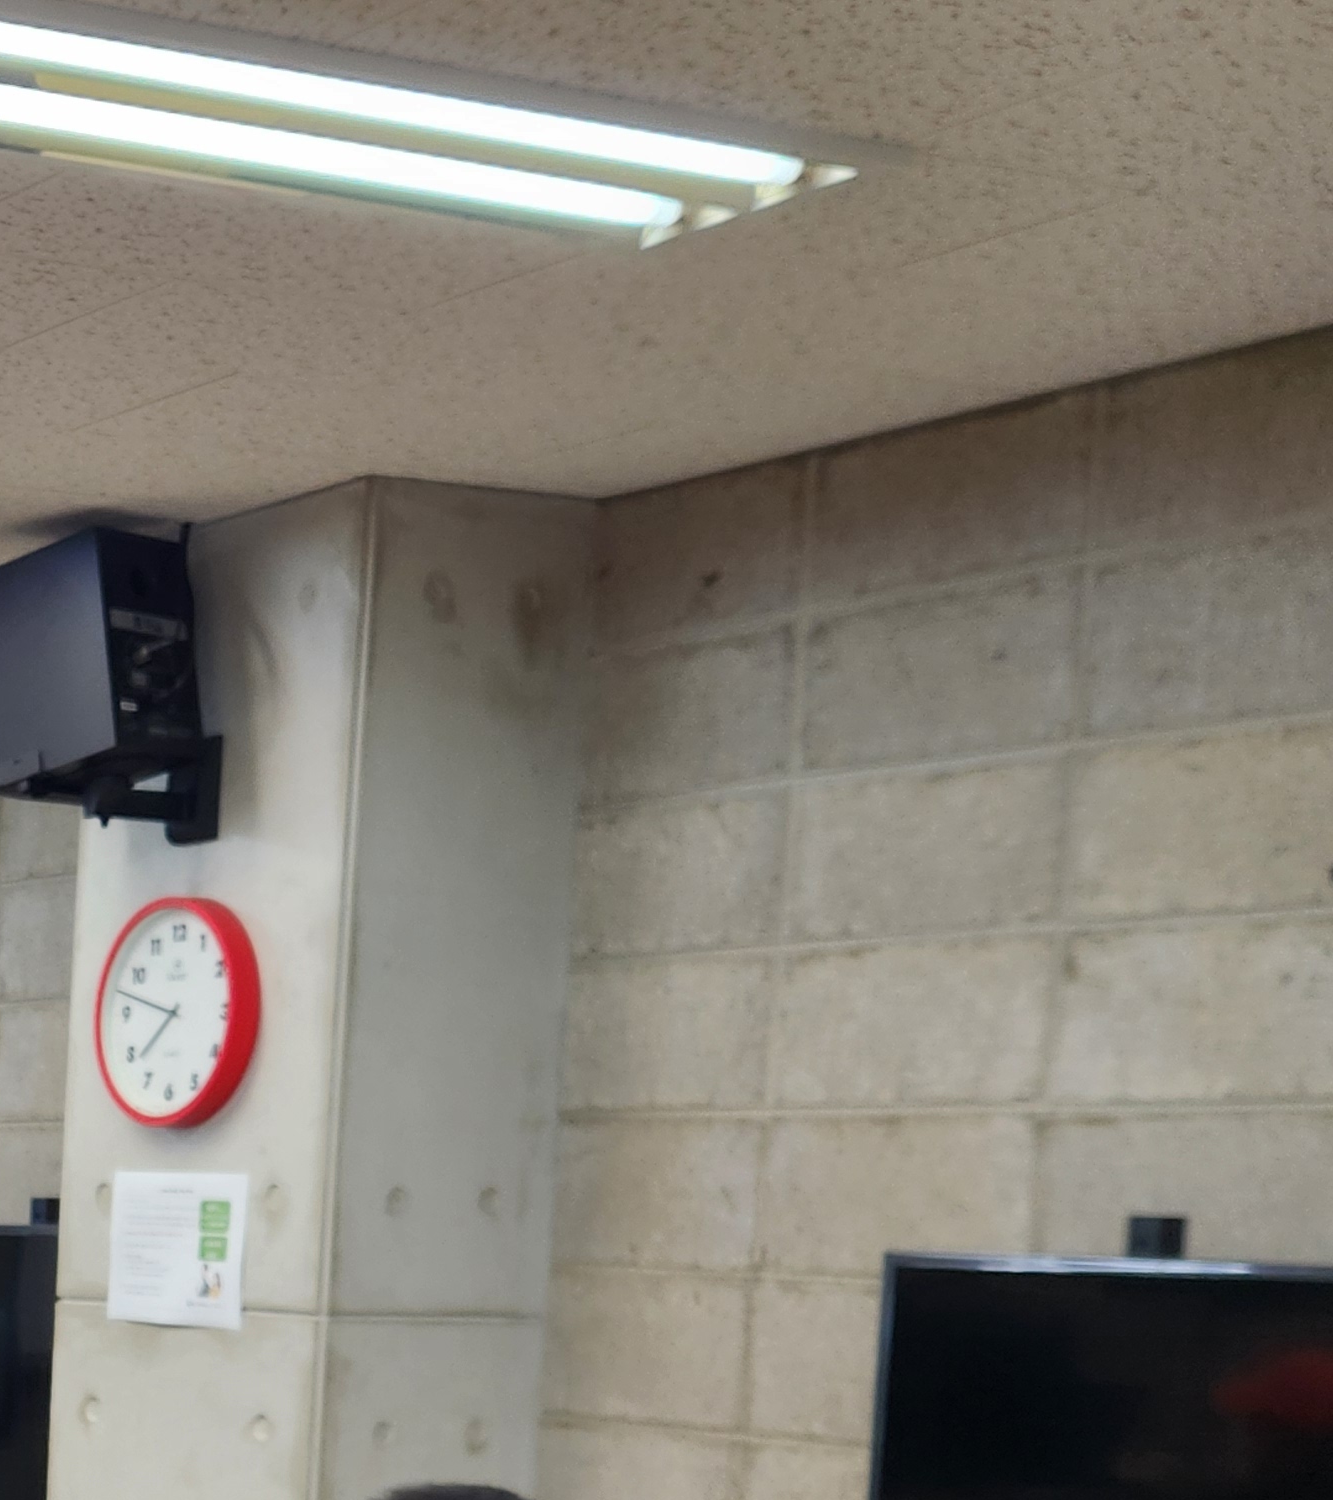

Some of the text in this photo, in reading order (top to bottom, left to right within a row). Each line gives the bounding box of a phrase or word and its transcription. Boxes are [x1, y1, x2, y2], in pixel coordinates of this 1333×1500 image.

[172, 924, 187, 943] 12
[150, 938, 162, 956] 11
[132, 967, 146, 985] 10
[121, 1005, 131, 1023] 9
[126, 1046, 135, 1063] 8
[143, 1071, 153, 1090] 7
[190, 1073, 199, 1091] 5
[164, 1083, 173, 1101] 6
